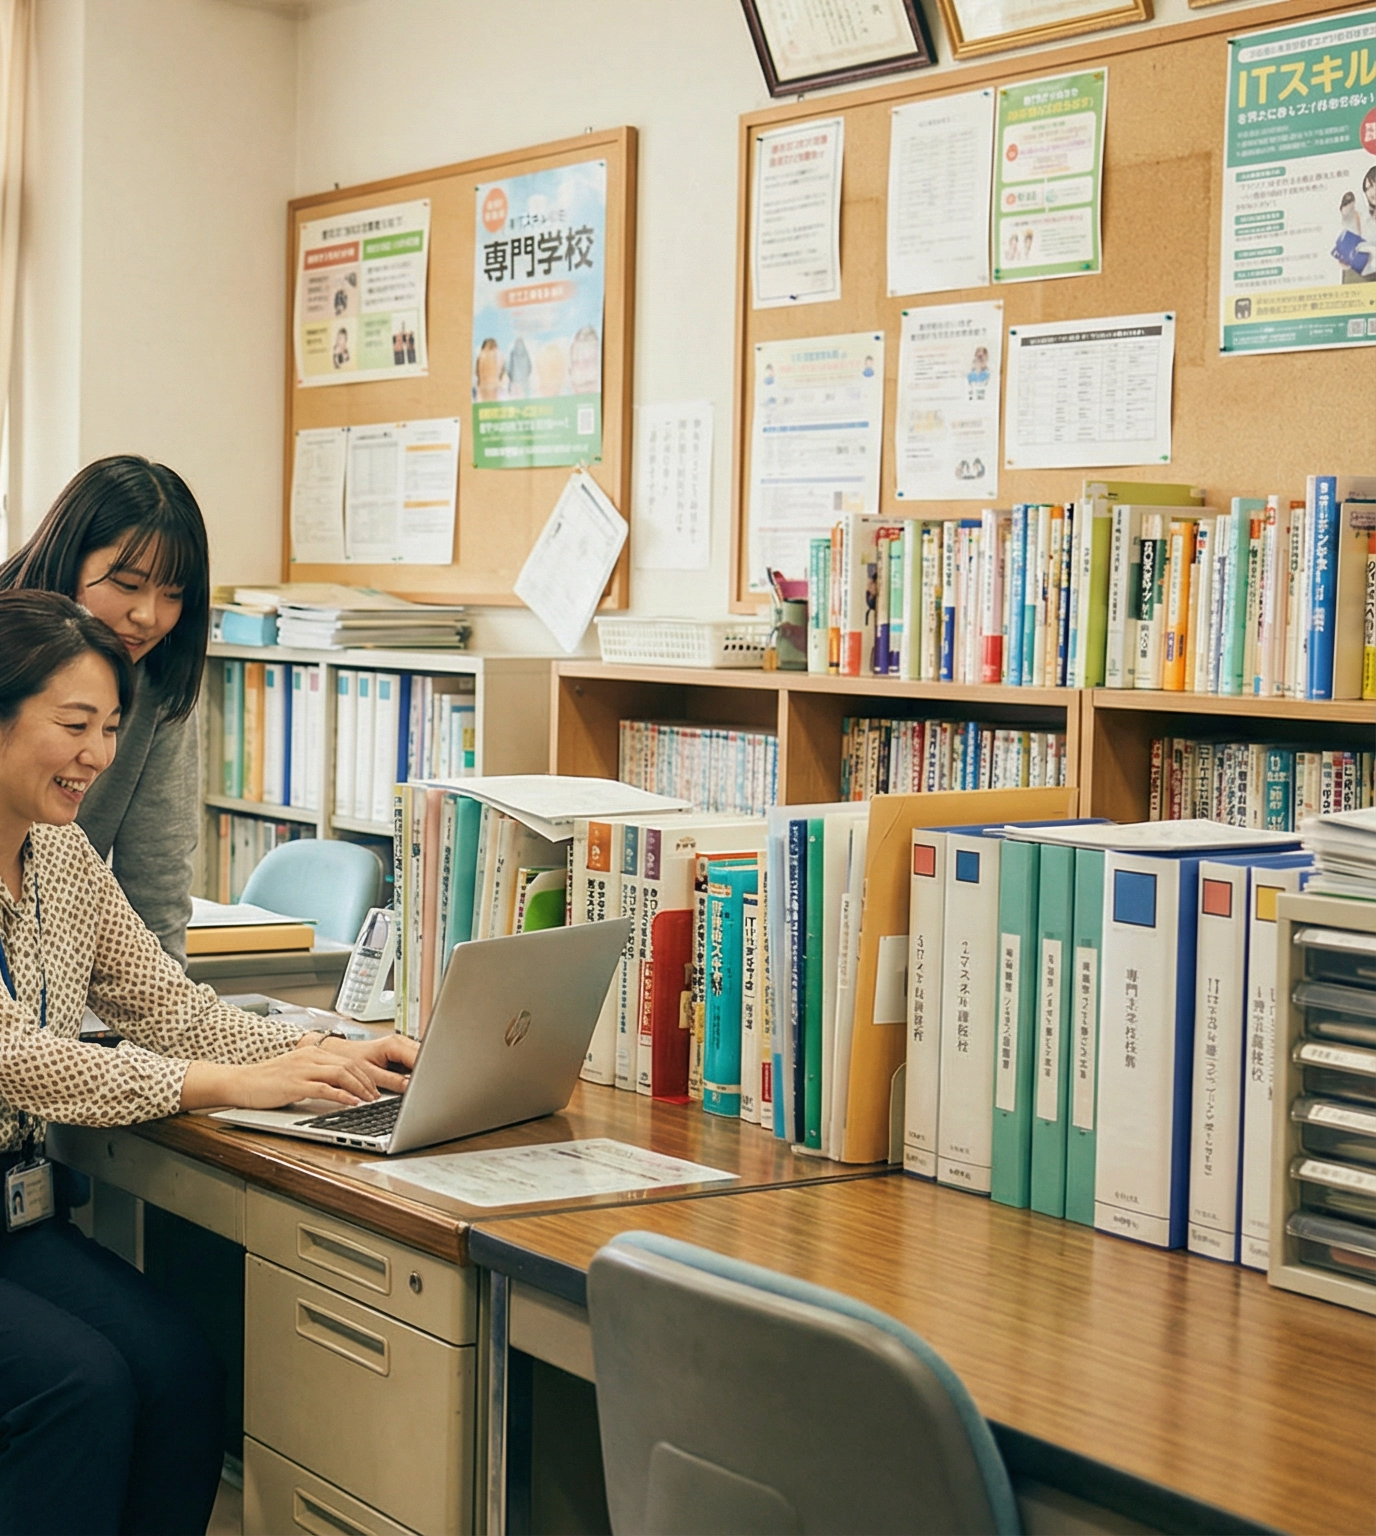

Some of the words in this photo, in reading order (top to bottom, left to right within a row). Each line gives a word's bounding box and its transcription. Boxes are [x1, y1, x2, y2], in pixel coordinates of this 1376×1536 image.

[1238, 48, 1376, 109] ITスキル
[483, 224, 595, 283] 専門学校
